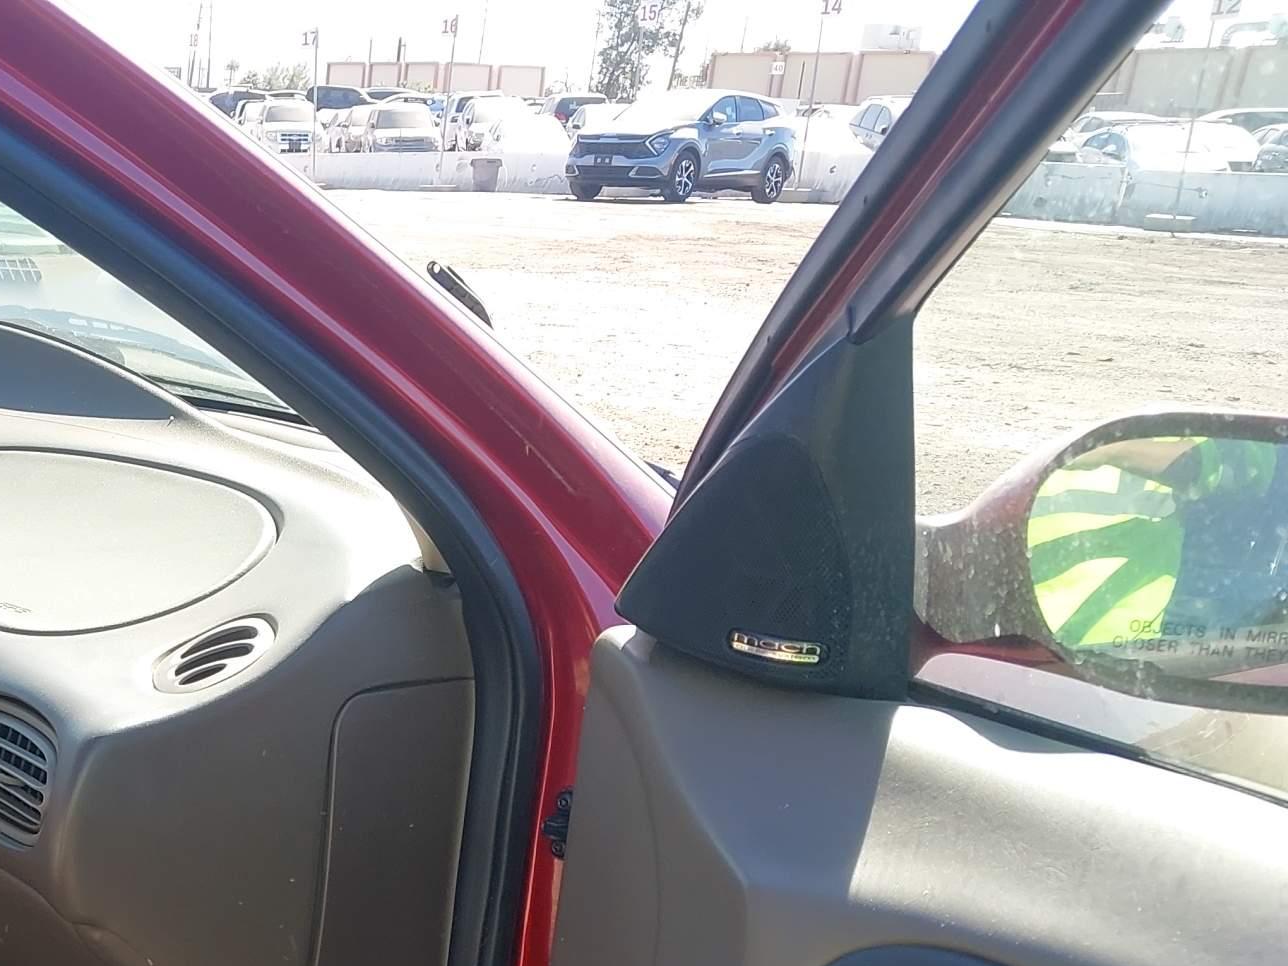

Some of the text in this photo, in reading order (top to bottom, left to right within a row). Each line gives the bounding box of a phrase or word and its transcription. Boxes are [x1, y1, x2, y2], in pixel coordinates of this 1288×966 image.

[640, 4, 658, 22] 15
[820, 0, 842, 15] 14
[301, 31, 318, 46] 17
[1129, 619, 1207, 639] OBJECTS
[1219, 626, 1237, 641] IN
[734, 632, 821, 656] mach
[1112, 635, 1178, 654] CLOSER
[1190, 641, 1234, 657] THAN
